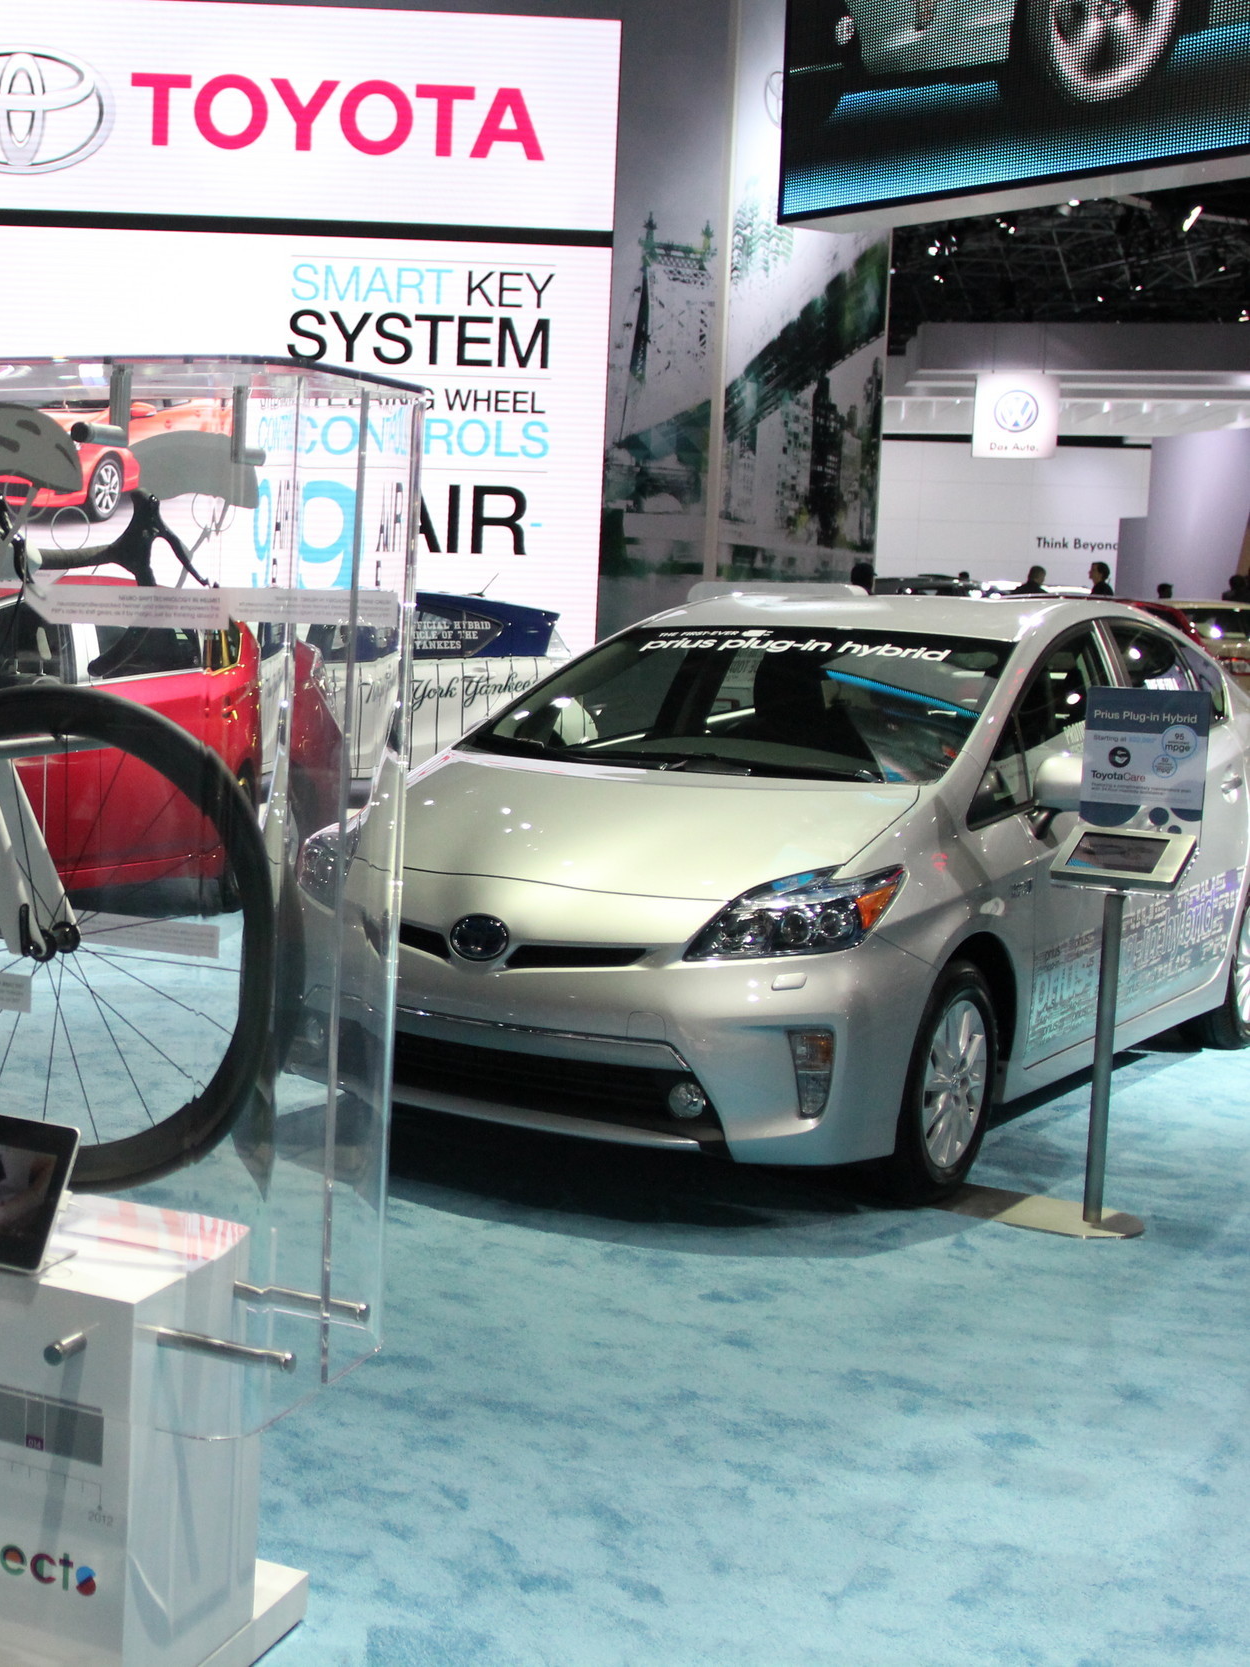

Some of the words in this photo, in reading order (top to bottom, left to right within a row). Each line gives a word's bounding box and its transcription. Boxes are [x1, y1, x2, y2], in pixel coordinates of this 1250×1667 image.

[131, 72, 545, 161] TOYOTA
[291, 263, 454, 304] SMART
[466, 270, 555, 309] KEY
[287, 309, 550, 369] SYSTEM
[445, 388, 546, 414] WHEEL
[1036, 536, 1069, 550] Think
[453, 620, 491, 630] HYBRID
[441, 631, 454, 639] OF
[457, 631, 479, 639] THE
[414, 641, 462, 650] YANKEES
[639, 637, 718, 652] prius
[717, 636, 833, 654] plug-in
[836, 640, 952, 662] hybrid
[411, 676, 459, 712] York
[1093, 709, 1120, 720] Prius
[1122, 711, 1160, 723] Plug-in
[1162, 713, 1198, 724] Hybrid
[1091, 769, 1146, 782] ToyotaCare
[88, 1510, 113, 1527] 2012
